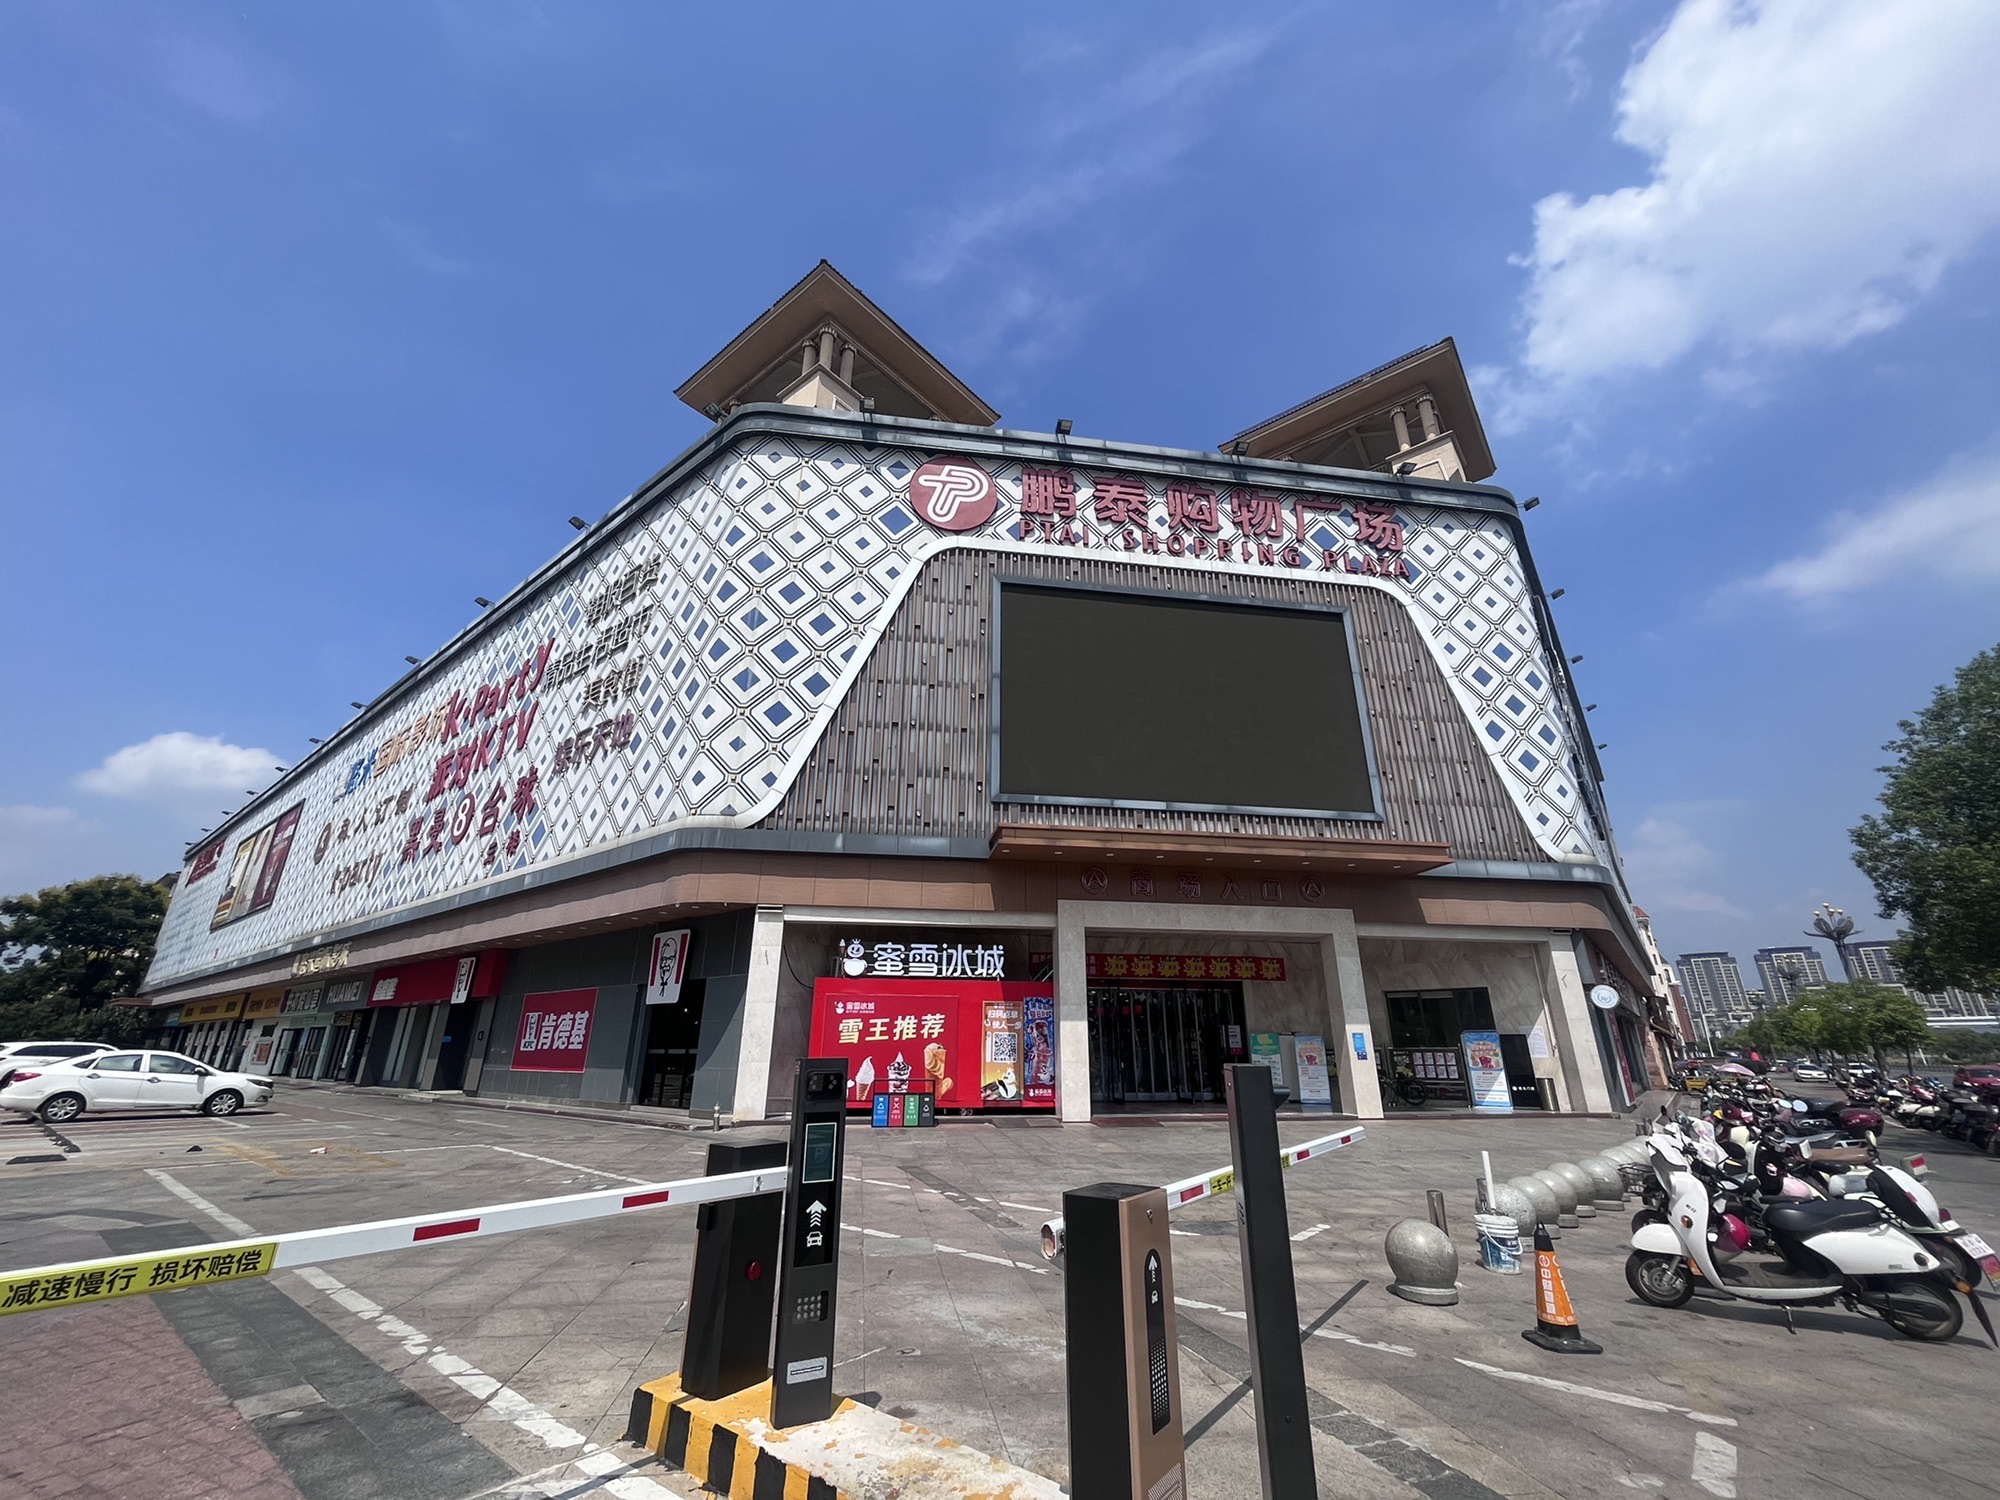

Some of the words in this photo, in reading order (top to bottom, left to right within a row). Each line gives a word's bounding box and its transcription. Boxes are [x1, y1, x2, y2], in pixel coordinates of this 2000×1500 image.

[1019, 466, 1407, 553] 鹏泰购物广场
[1322, 549, 1412, 579] PLAZA
[541, 604, 655, 696] 精品生活超市
[580, 654, 646, 716] 美食街
[426, 701, 540, 804] 派对KTV
[552, 707, 635, 777] 娱乐天地
[1130, 870, 1283, 902] 商场入口
[873, 941, 1006, 979] 蜜雪冰城
[326, 981, 364, 1005] HUAWEI
[522, 1040, 535, 1049] KFC
[536, 1010, 589, 1050] 肯德基
[838, 1013, 946, 1045] 雪王推荐
[1, 1266, 139, 1309] 减速慢行
[148, 1249, 263, 1288] 损坏赔偿
